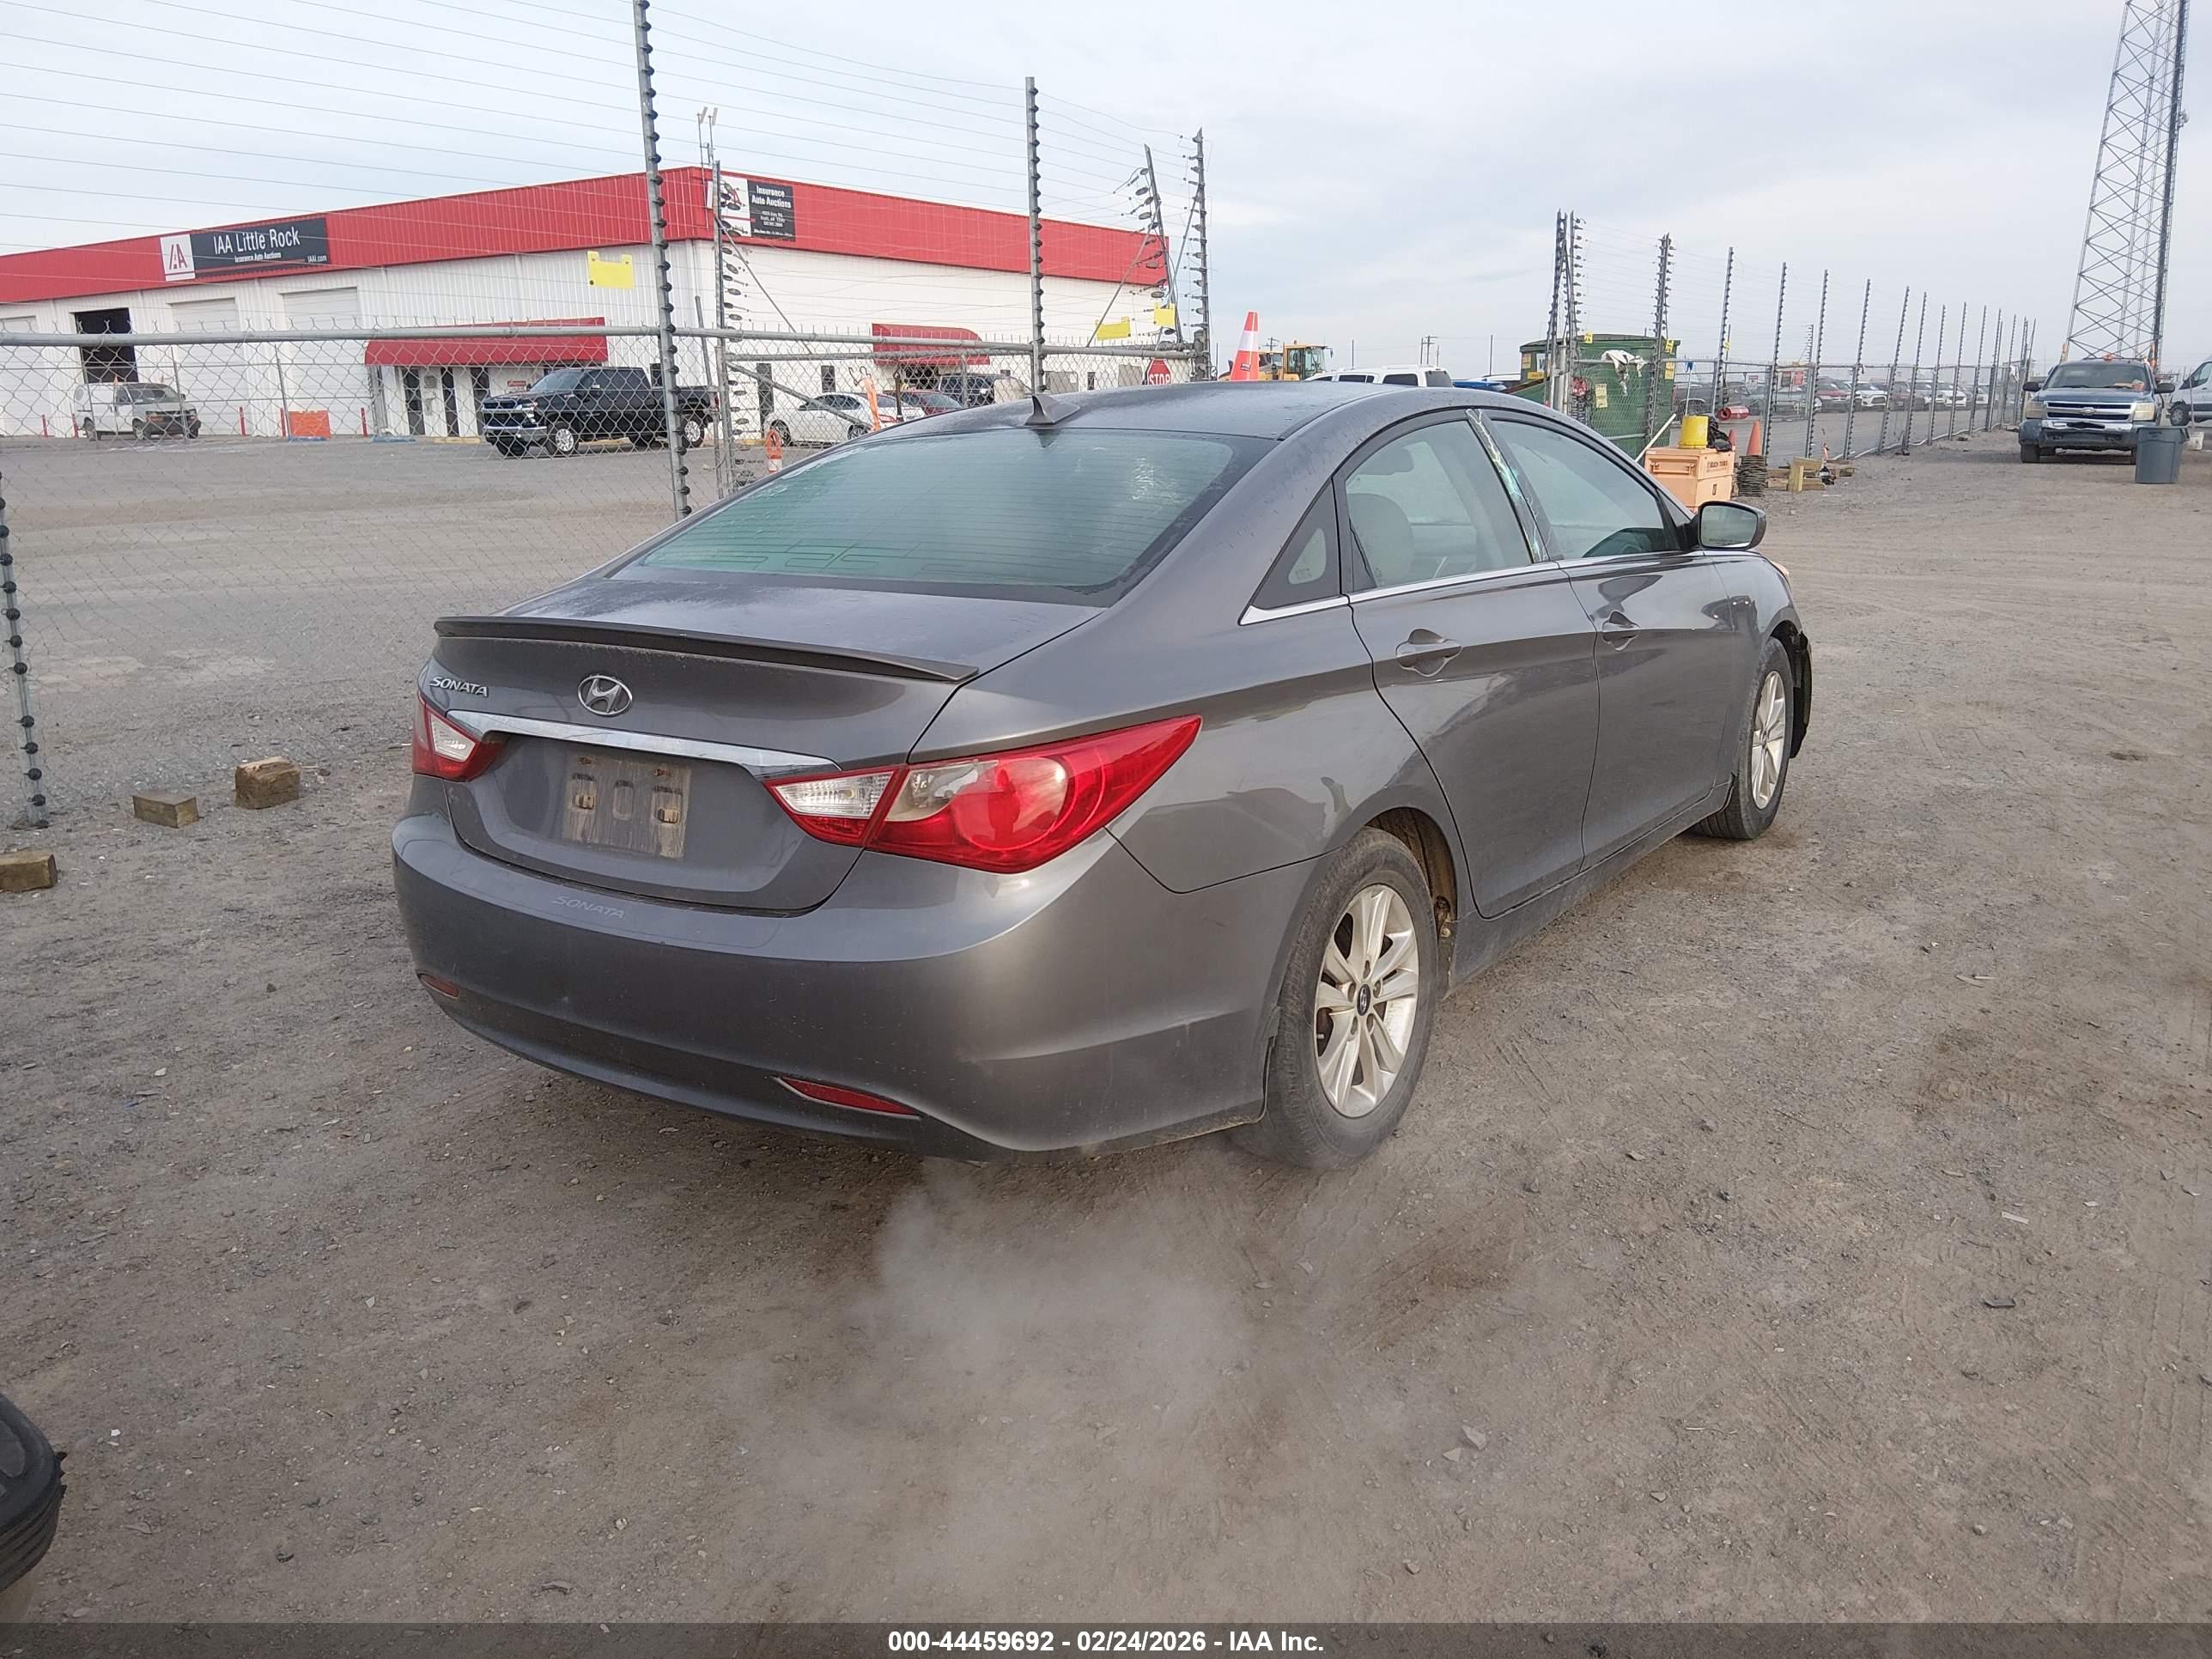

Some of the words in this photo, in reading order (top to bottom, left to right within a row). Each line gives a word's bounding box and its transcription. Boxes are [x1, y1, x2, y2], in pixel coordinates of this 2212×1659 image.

[756, 185, 785, 198] Insurance
[751, 194, 765, 205] Auto
[766, 196, 792, 209] Auctions
[213, 234, 234, 255] IAA
[235, 231, 266, 252] Little
[269, 227, 301, 248] Rock
[1149, 373, 1171, 386] STOP
[429, 676, 489, 698] SONATA
[552, 895, 626, 920] SONATA
